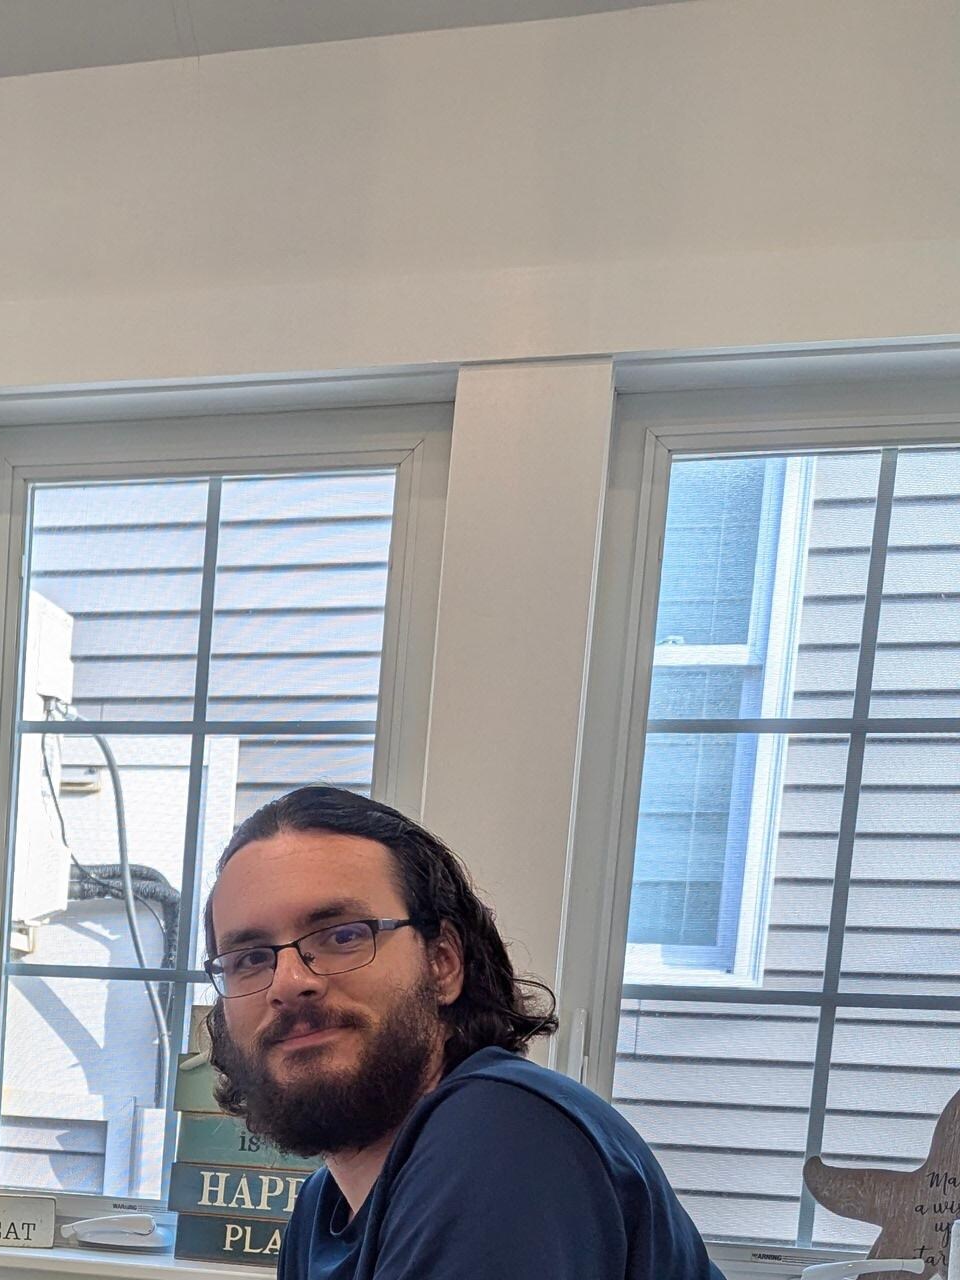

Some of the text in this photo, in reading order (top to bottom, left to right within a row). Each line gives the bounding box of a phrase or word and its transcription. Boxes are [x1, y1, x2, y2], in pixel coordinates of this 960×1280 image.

[239, 1131, 260, 1152] is
[197, 1171, 305, 1212] HAPP
[927, 1171, 960, 1195] Ma
[223, 1224, 283, 1255] PLA
[913, 1245, 948, 1266] tar
